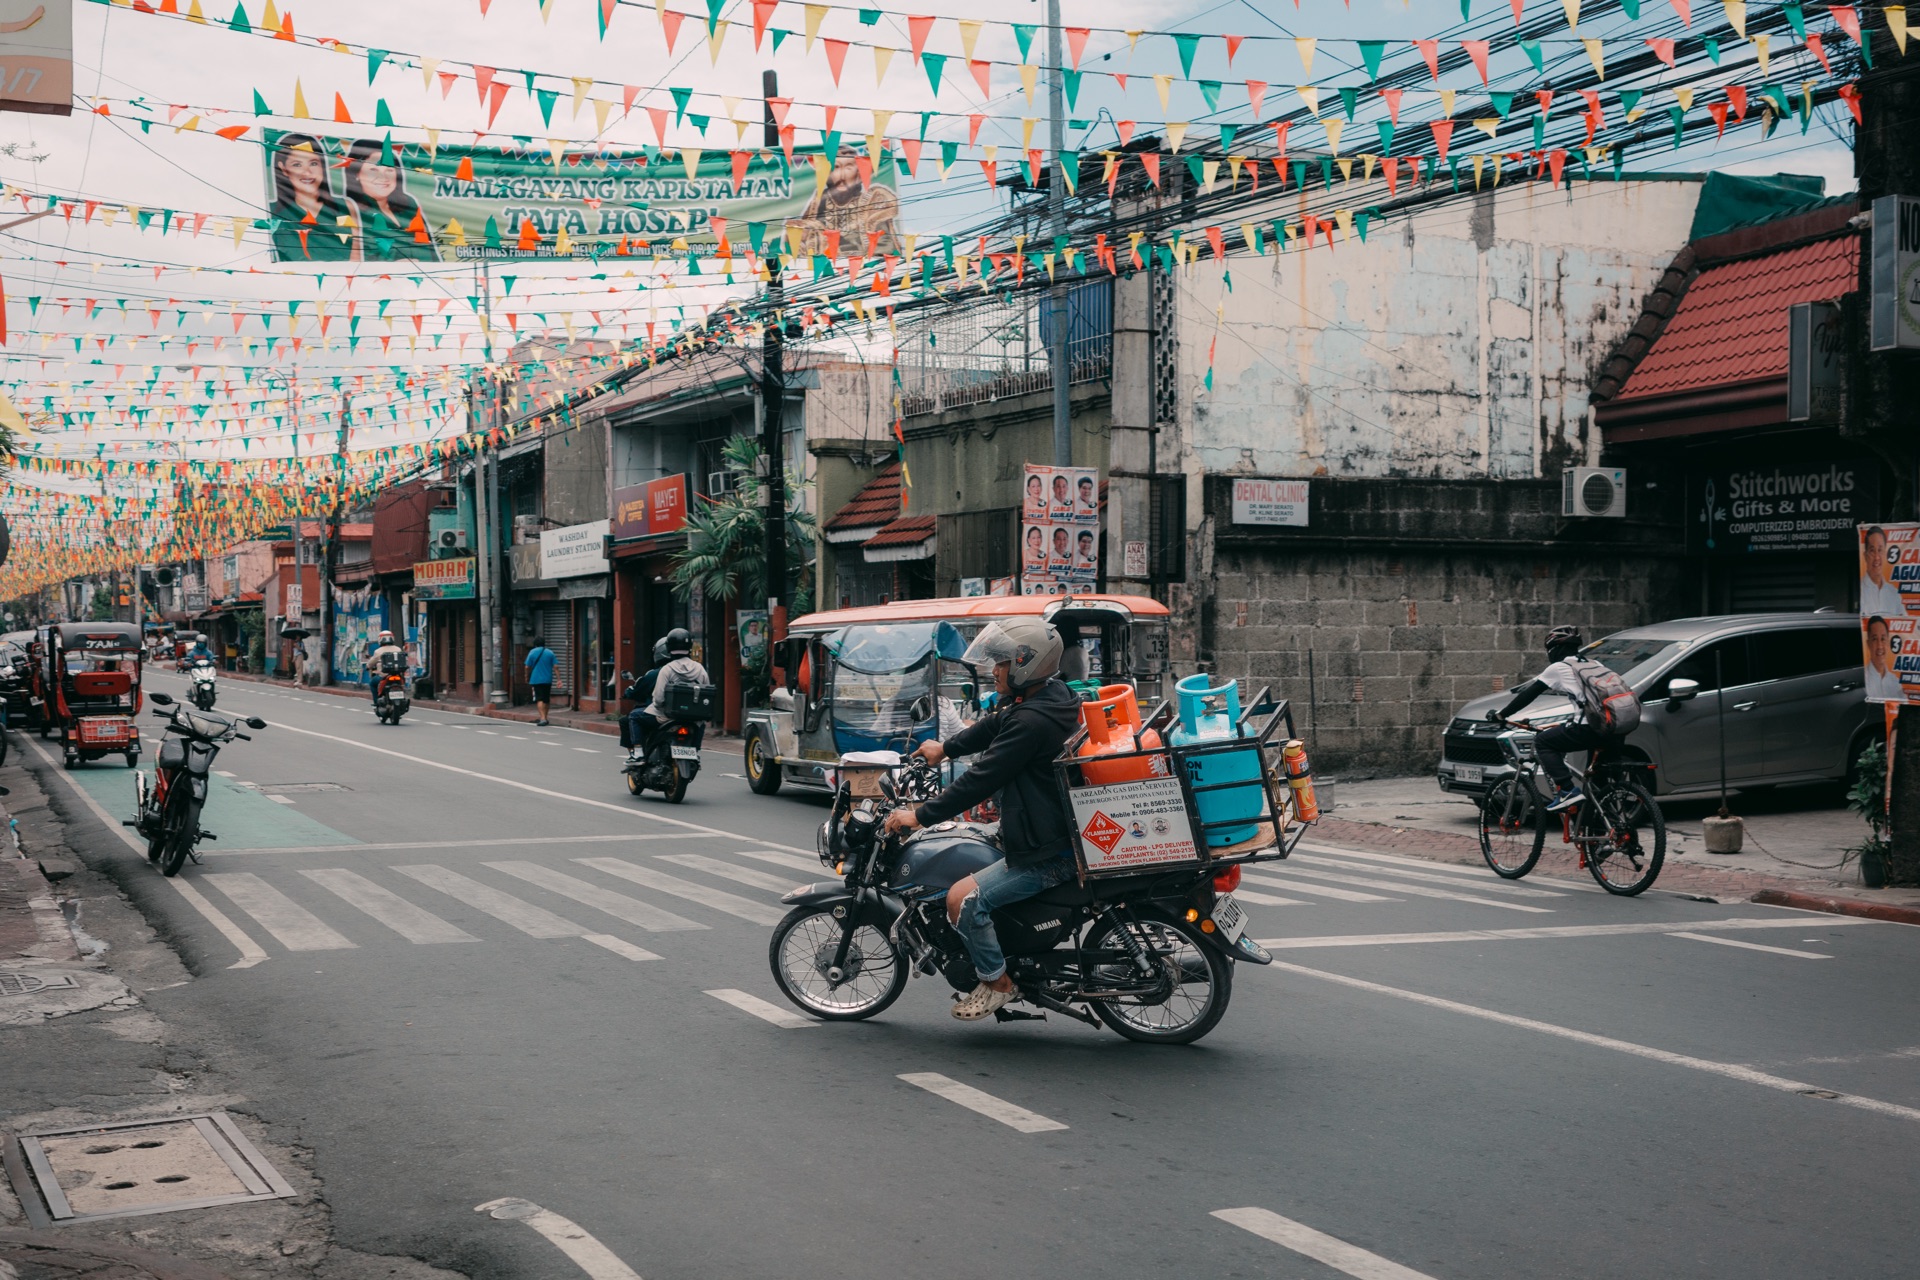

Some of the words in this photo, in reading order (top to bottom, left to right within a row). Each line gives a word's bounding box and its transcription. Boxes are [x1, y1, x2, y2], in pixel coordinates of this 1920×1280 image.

[434, 177, 616, 200] MALIGAYANG
[623, 178, 792, 200] KAPISTAHAN
[504, 207, 587, 235] TATA
[456, 246, 507, 258] GREETINGS
[1729, 464, 1854, 498] Stitchworks
[655, 488, 678, 509] MAYET
[1237, 483, 1272, 501] DENTAL
[1276, 484, 1306, 503] CLINIC
[1732, 500, 1773, 518] Gifts
[1779, 500, 1795, 513] &
[1801, 498, 1851, 512] More
[1729, 521, 1794, 533] COMPUTERIZED
[1797, 518, 1854, 531] EMBROIDERY
[559, 531, 588, 543] WASHDAY
[1887, 530, 1914, 541] VOTE
[547, 546, 573, 558] LAUNDRY
[575, 542, 601, 554] STATION
[1127, 543, 1146, 554] ANAY
[1888, 548, 1899, 562] 3
[415, 561, 467, 579] MORAN
[415, 577, 467, 585] COMPUTERSHOP
[1889, 620, 1914, 631] VOTE
[1891, 638, 1900, 653] 3
[1081, 788, 1112, 798] ARZADON
[1145, 781, 1178, 790] SERVICES
[1121, 792, 1151, 800] PAMPLONA
[1150, 799, 1182, 807] 8569-3330
[1087, 829, 1119, 837] FLAMMABLE
[1165, 841, 1193, 849] DELIVERY
[1117, 851, 1155, 860] COMPLAINTS:
[1033, 919, 1061, 932] YAMAHA
